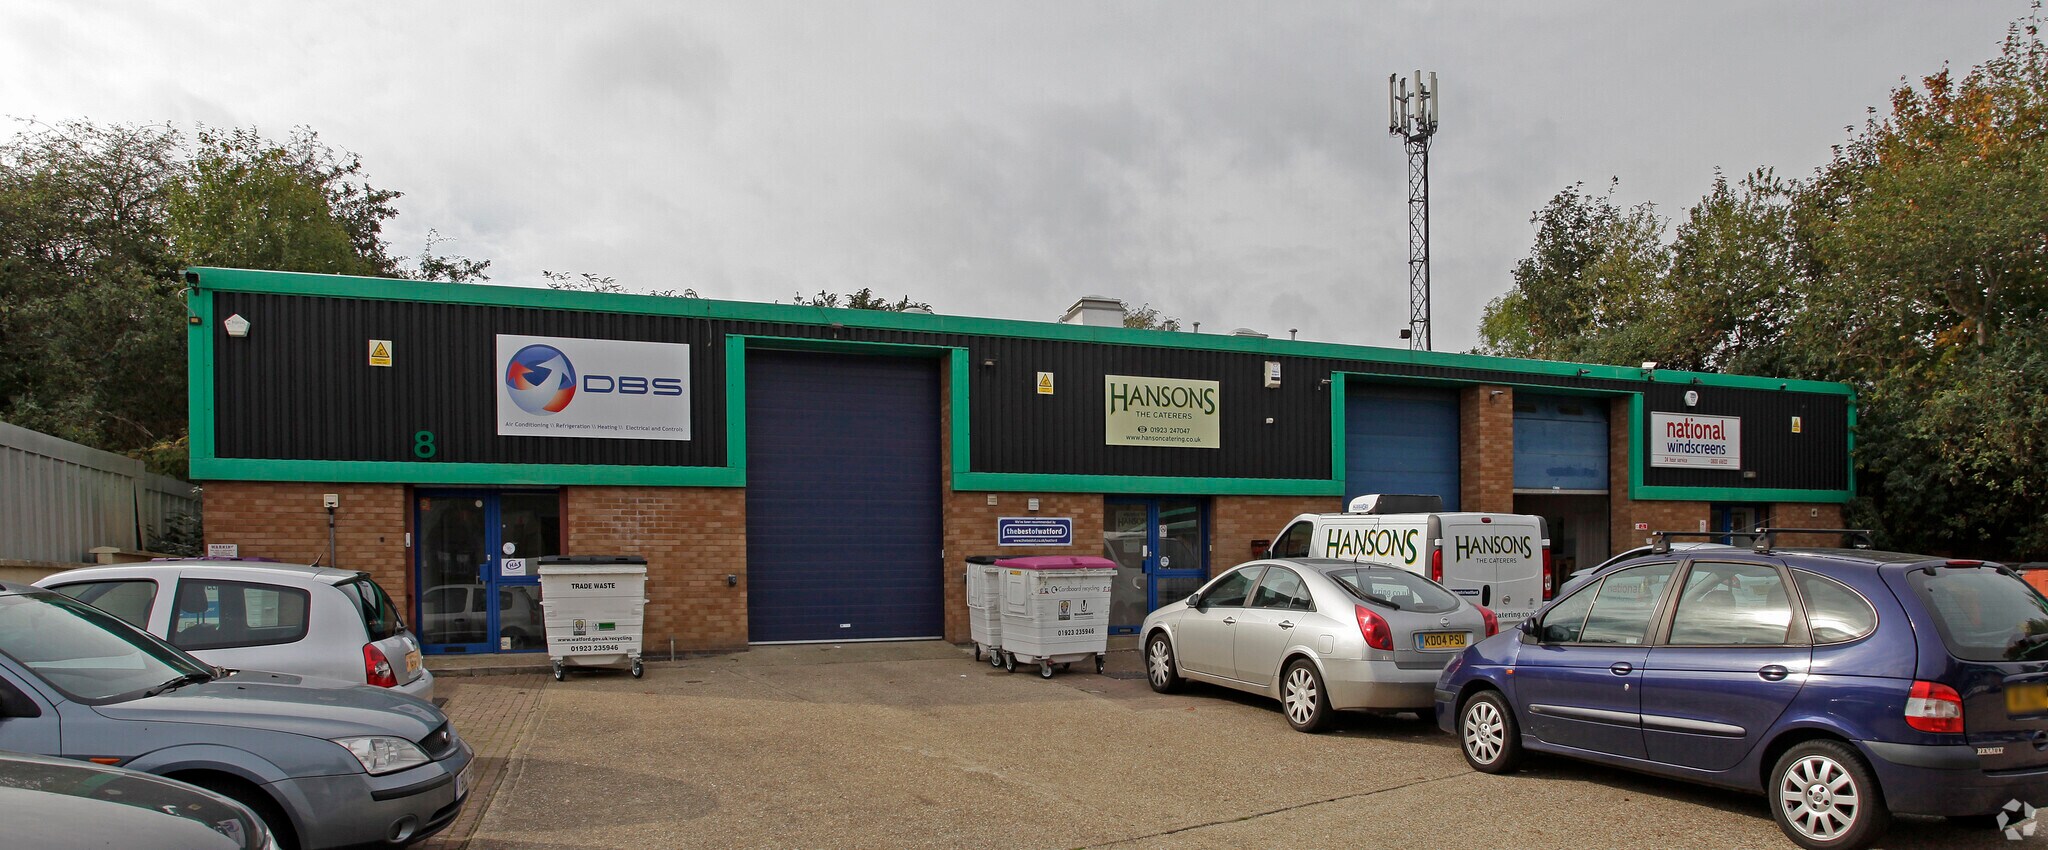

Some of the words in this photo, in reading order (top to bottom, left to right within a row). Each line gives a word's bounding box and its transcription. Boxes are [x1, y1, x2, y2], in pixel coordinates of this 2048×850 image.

[583, 374, 683, 397] DBS
[1110, 382, 1216, 415] HANSONS
[1153, 411, 1192, 420] CATERERS
[515, 421, 549, 429] Conditioning
[1150, 426, 1168, 434] 01923
[1666, 417, 1726, 441] national
[413, 430, 436, 458] 8
[1667, 440, 1726, 455] windscreens
[1006, 527, 1063, 535] thebestofwatford
[1326, 528, 1419, 565] HANSONS
[1455, 535, 1532, 563] HANSONS
[505, 559, 522, 570] CHAS
[571, 582, 593, 590] TRADE
[1058, 585, 1082, 593] Cardboard
[1082, 584, 1100, 593] recycling
[1058, 628, 1075, 637] 01923
[1075, 627, 1095, 635] 235946
[1424, 633, 1447, 647] KD04
[1449, 632, 1465, 646] PSU
[1976, 746, 2004, 755] RENAULT
